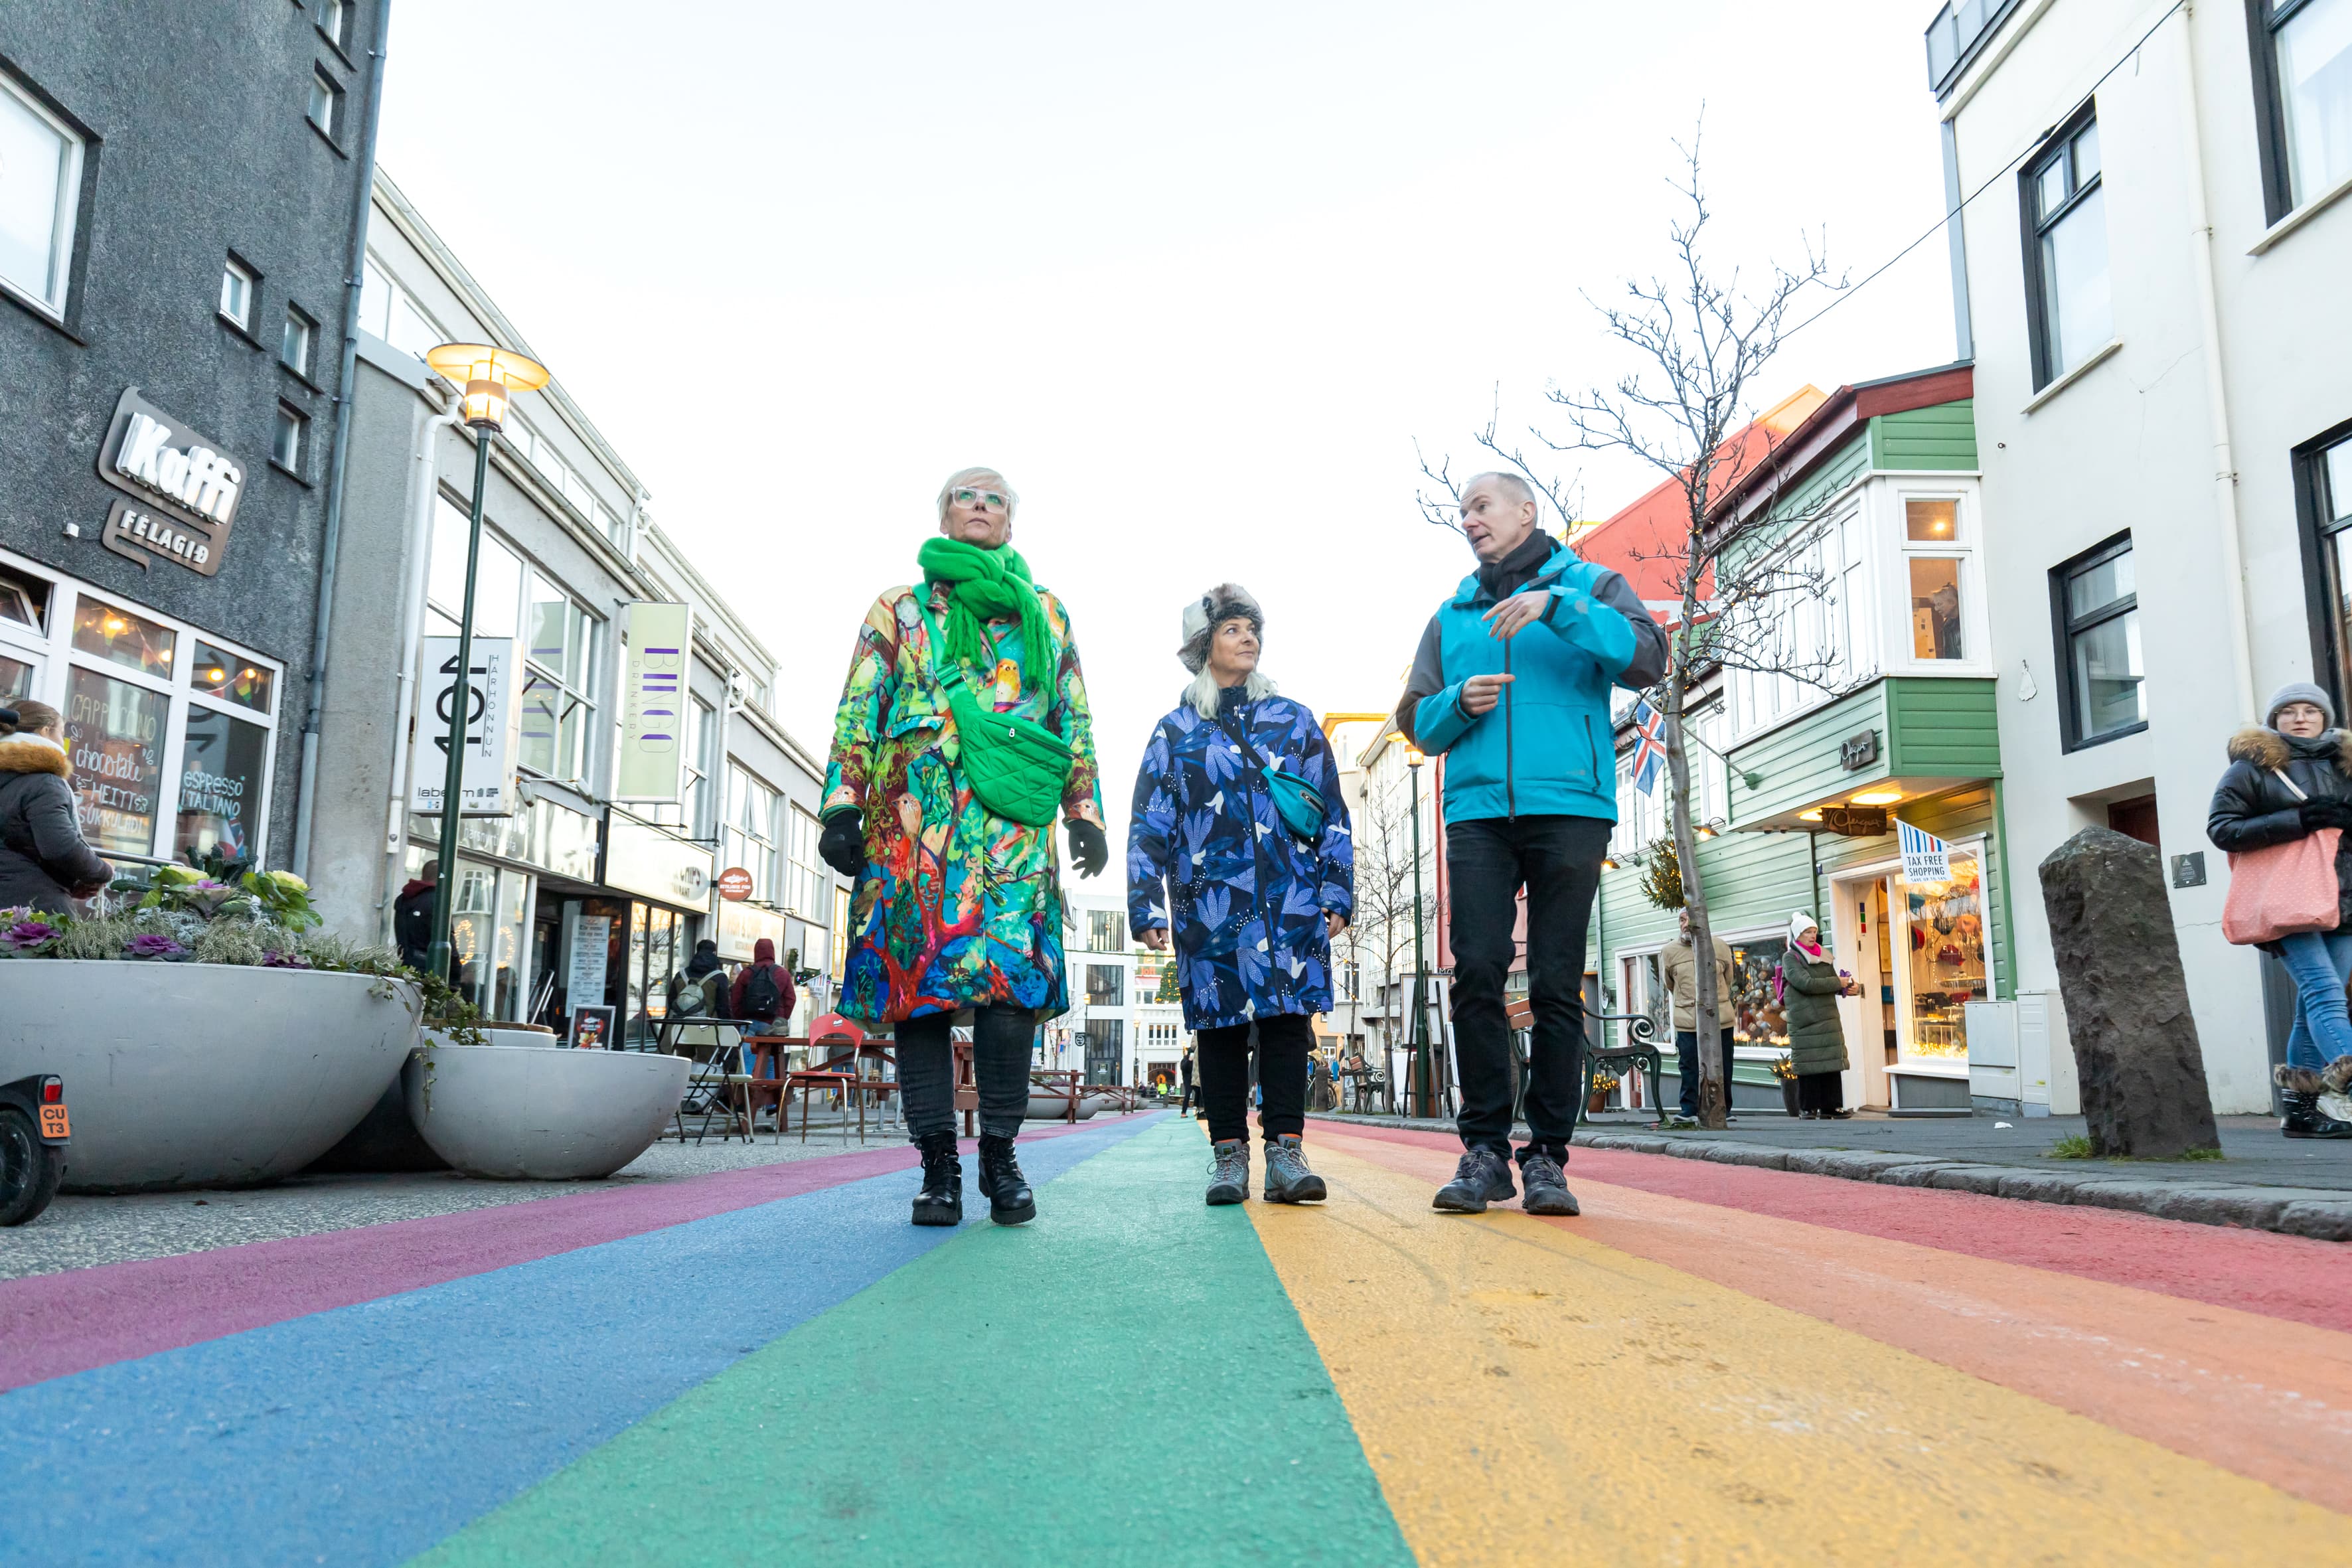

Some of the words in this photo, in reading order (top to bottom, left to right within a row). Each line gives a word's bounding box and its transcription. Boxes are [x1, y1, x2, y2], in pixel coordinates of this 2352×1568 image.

[116, 412, 241, 526] Kaffi
[119, 509, 209, 564] FÉLAGIÐ
[433, 655, 487, 755] 101
[628, 660, 640, 740] DRINKERY
[639, 647, 679, 753] BINGO
[76, 743, 143, 782] chocolate
[91, 781, 139, 811] HEITT
[181, 789, 241, 817] ITALIANO
[418, 787, 474, 797] labem
[1907, 856, 1922, 866] TAX
[1924, 855, 1943, 865] FREE
[1909, 866, 1945, 877] SHOPPING
[43, 1109, 65, 1120] CU
[46, 1123, 64, 1134] T3
